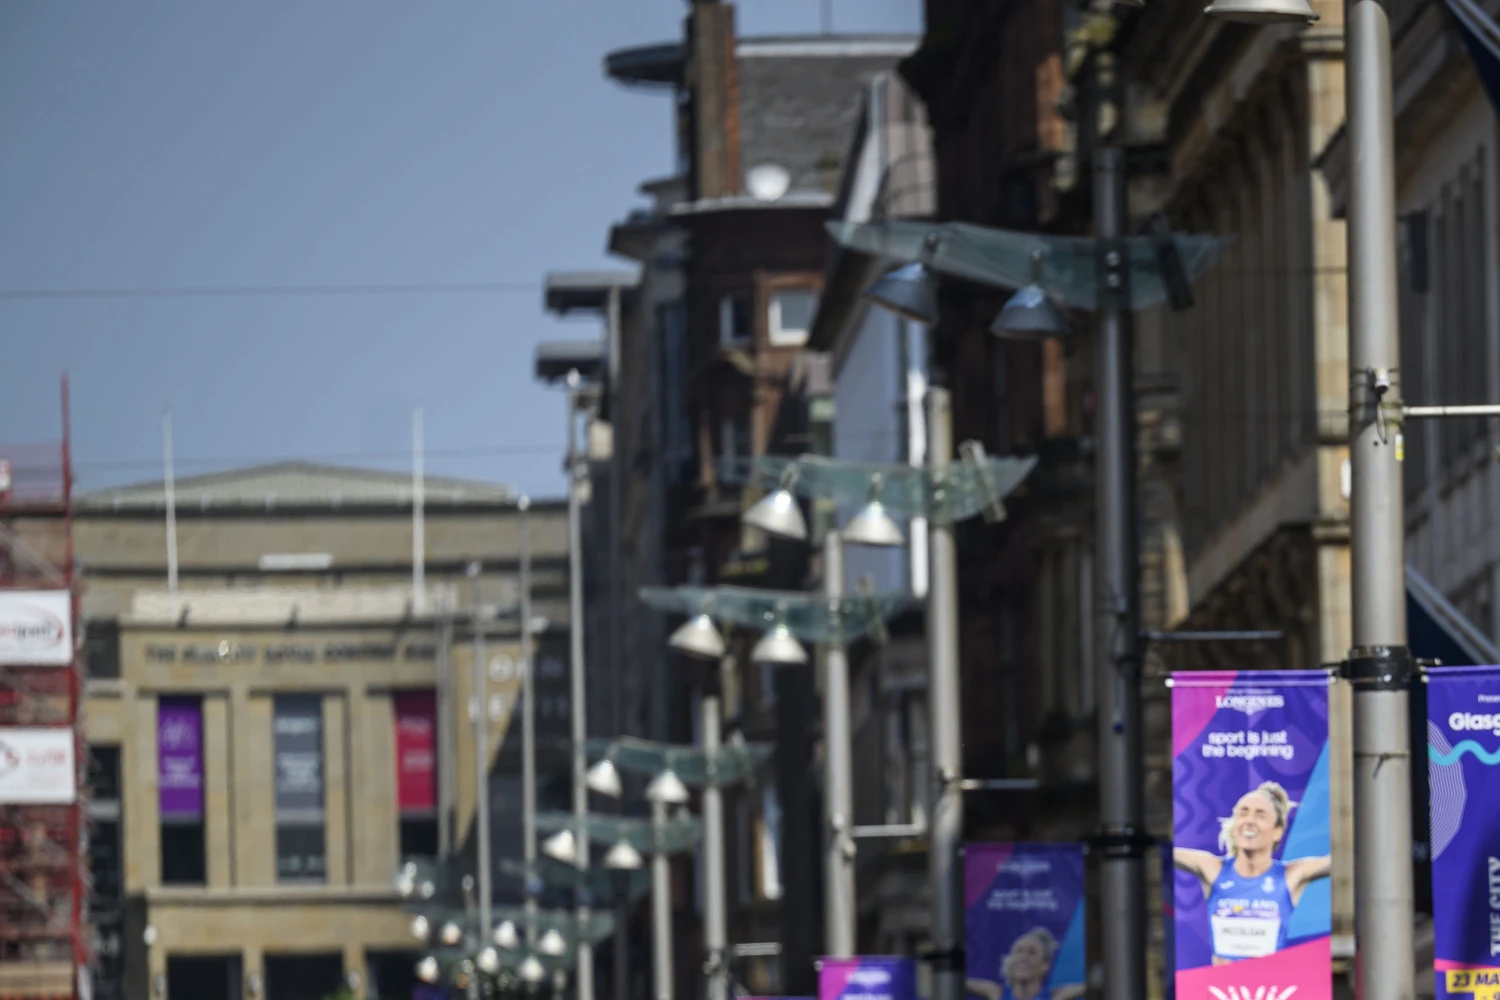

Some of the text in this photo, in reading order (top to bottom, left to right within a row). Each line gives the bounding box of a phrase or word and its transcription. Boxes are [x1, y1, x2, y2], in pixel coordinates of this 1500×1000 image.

[1208, 730, 1287, 746] sport is just
[1202, 744, 1294, 760] the beginning
[1452, 974, 1471, 987] 23
